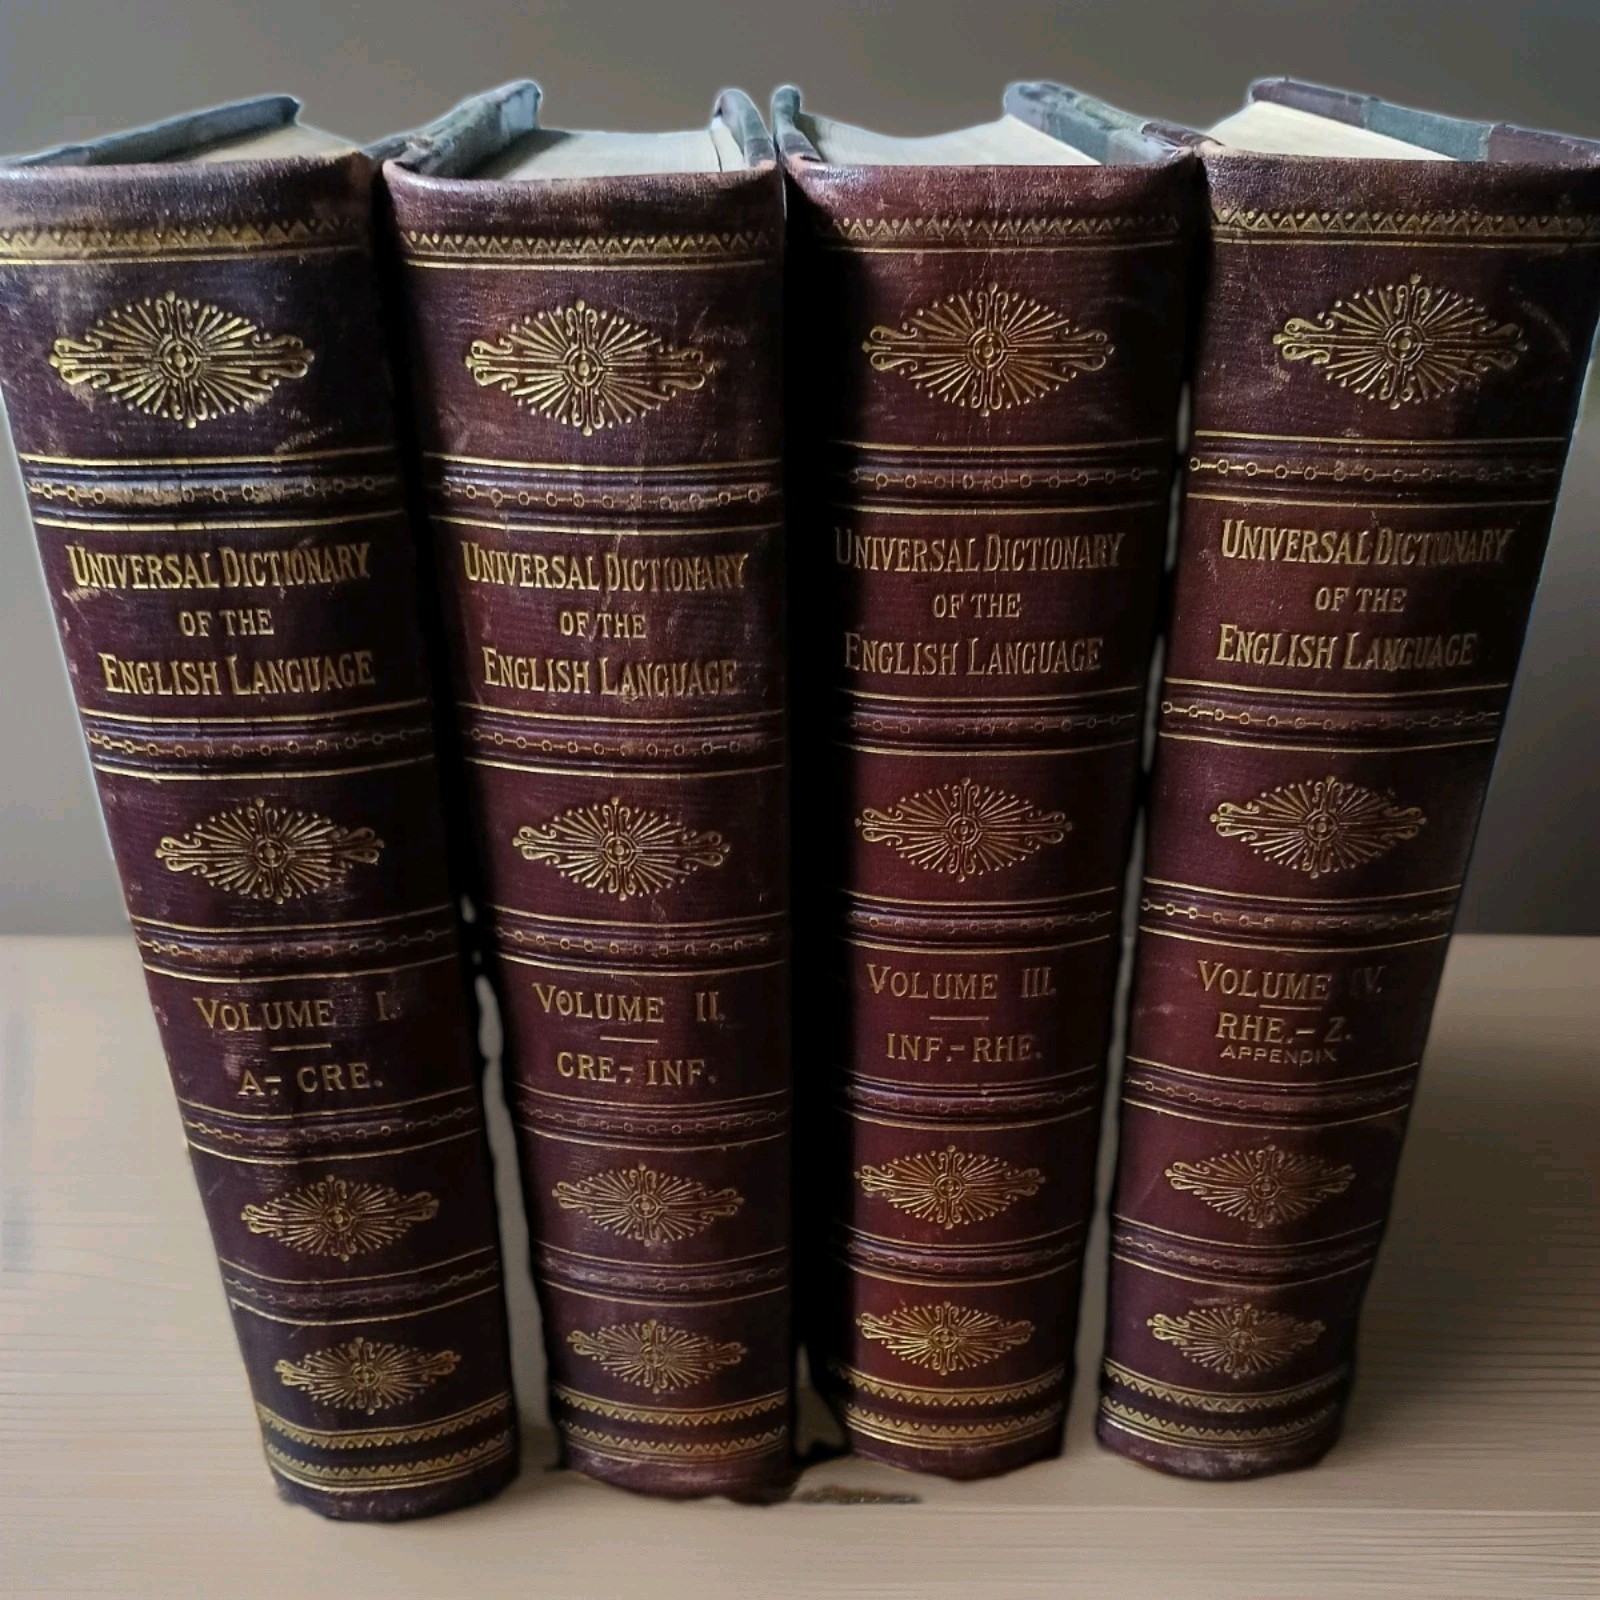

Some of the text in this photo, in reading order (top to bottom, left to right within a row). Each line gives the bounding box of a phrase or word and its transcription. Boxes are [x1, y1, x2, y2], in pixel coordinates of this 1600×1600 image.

[835, 526, 1126, 573] UNIVERSAL DICTIONARY
[1221, 519, 1514, 566] UNIVERSAL DICTIONARY
[65, 542, 371, 589] UNIVERSAL DICTIONARY
[461, 541, 749, 592] UNIVERSAL DICTIONARY
[933, 592, 1022, 619] OF THE
[1314, 587, 1408, 613] OF THE
[179, 608, 274, 637] OF THE
[559, 611, 647, 638] OF THE
[844, 631, 1104, 676] ENGLISH LANGUAGE
[1216, 623, 1478, 673] ENGLISH LANGUAGE
[97, 651, 376, 696] ENGLISH LANGUAGE
[481, 647, 740, 698] ENGLISH LANGUAGE
[866, 963, 1057, 1000] VOLUME III.
[1197, 959, 1332, 1001] VOLUME
[192, 990, 398, 1032] VOLUME I.
[531, 982, 665, 1024] VOLUME
[1219, 1045, 1338, 1066] APPENDIX
